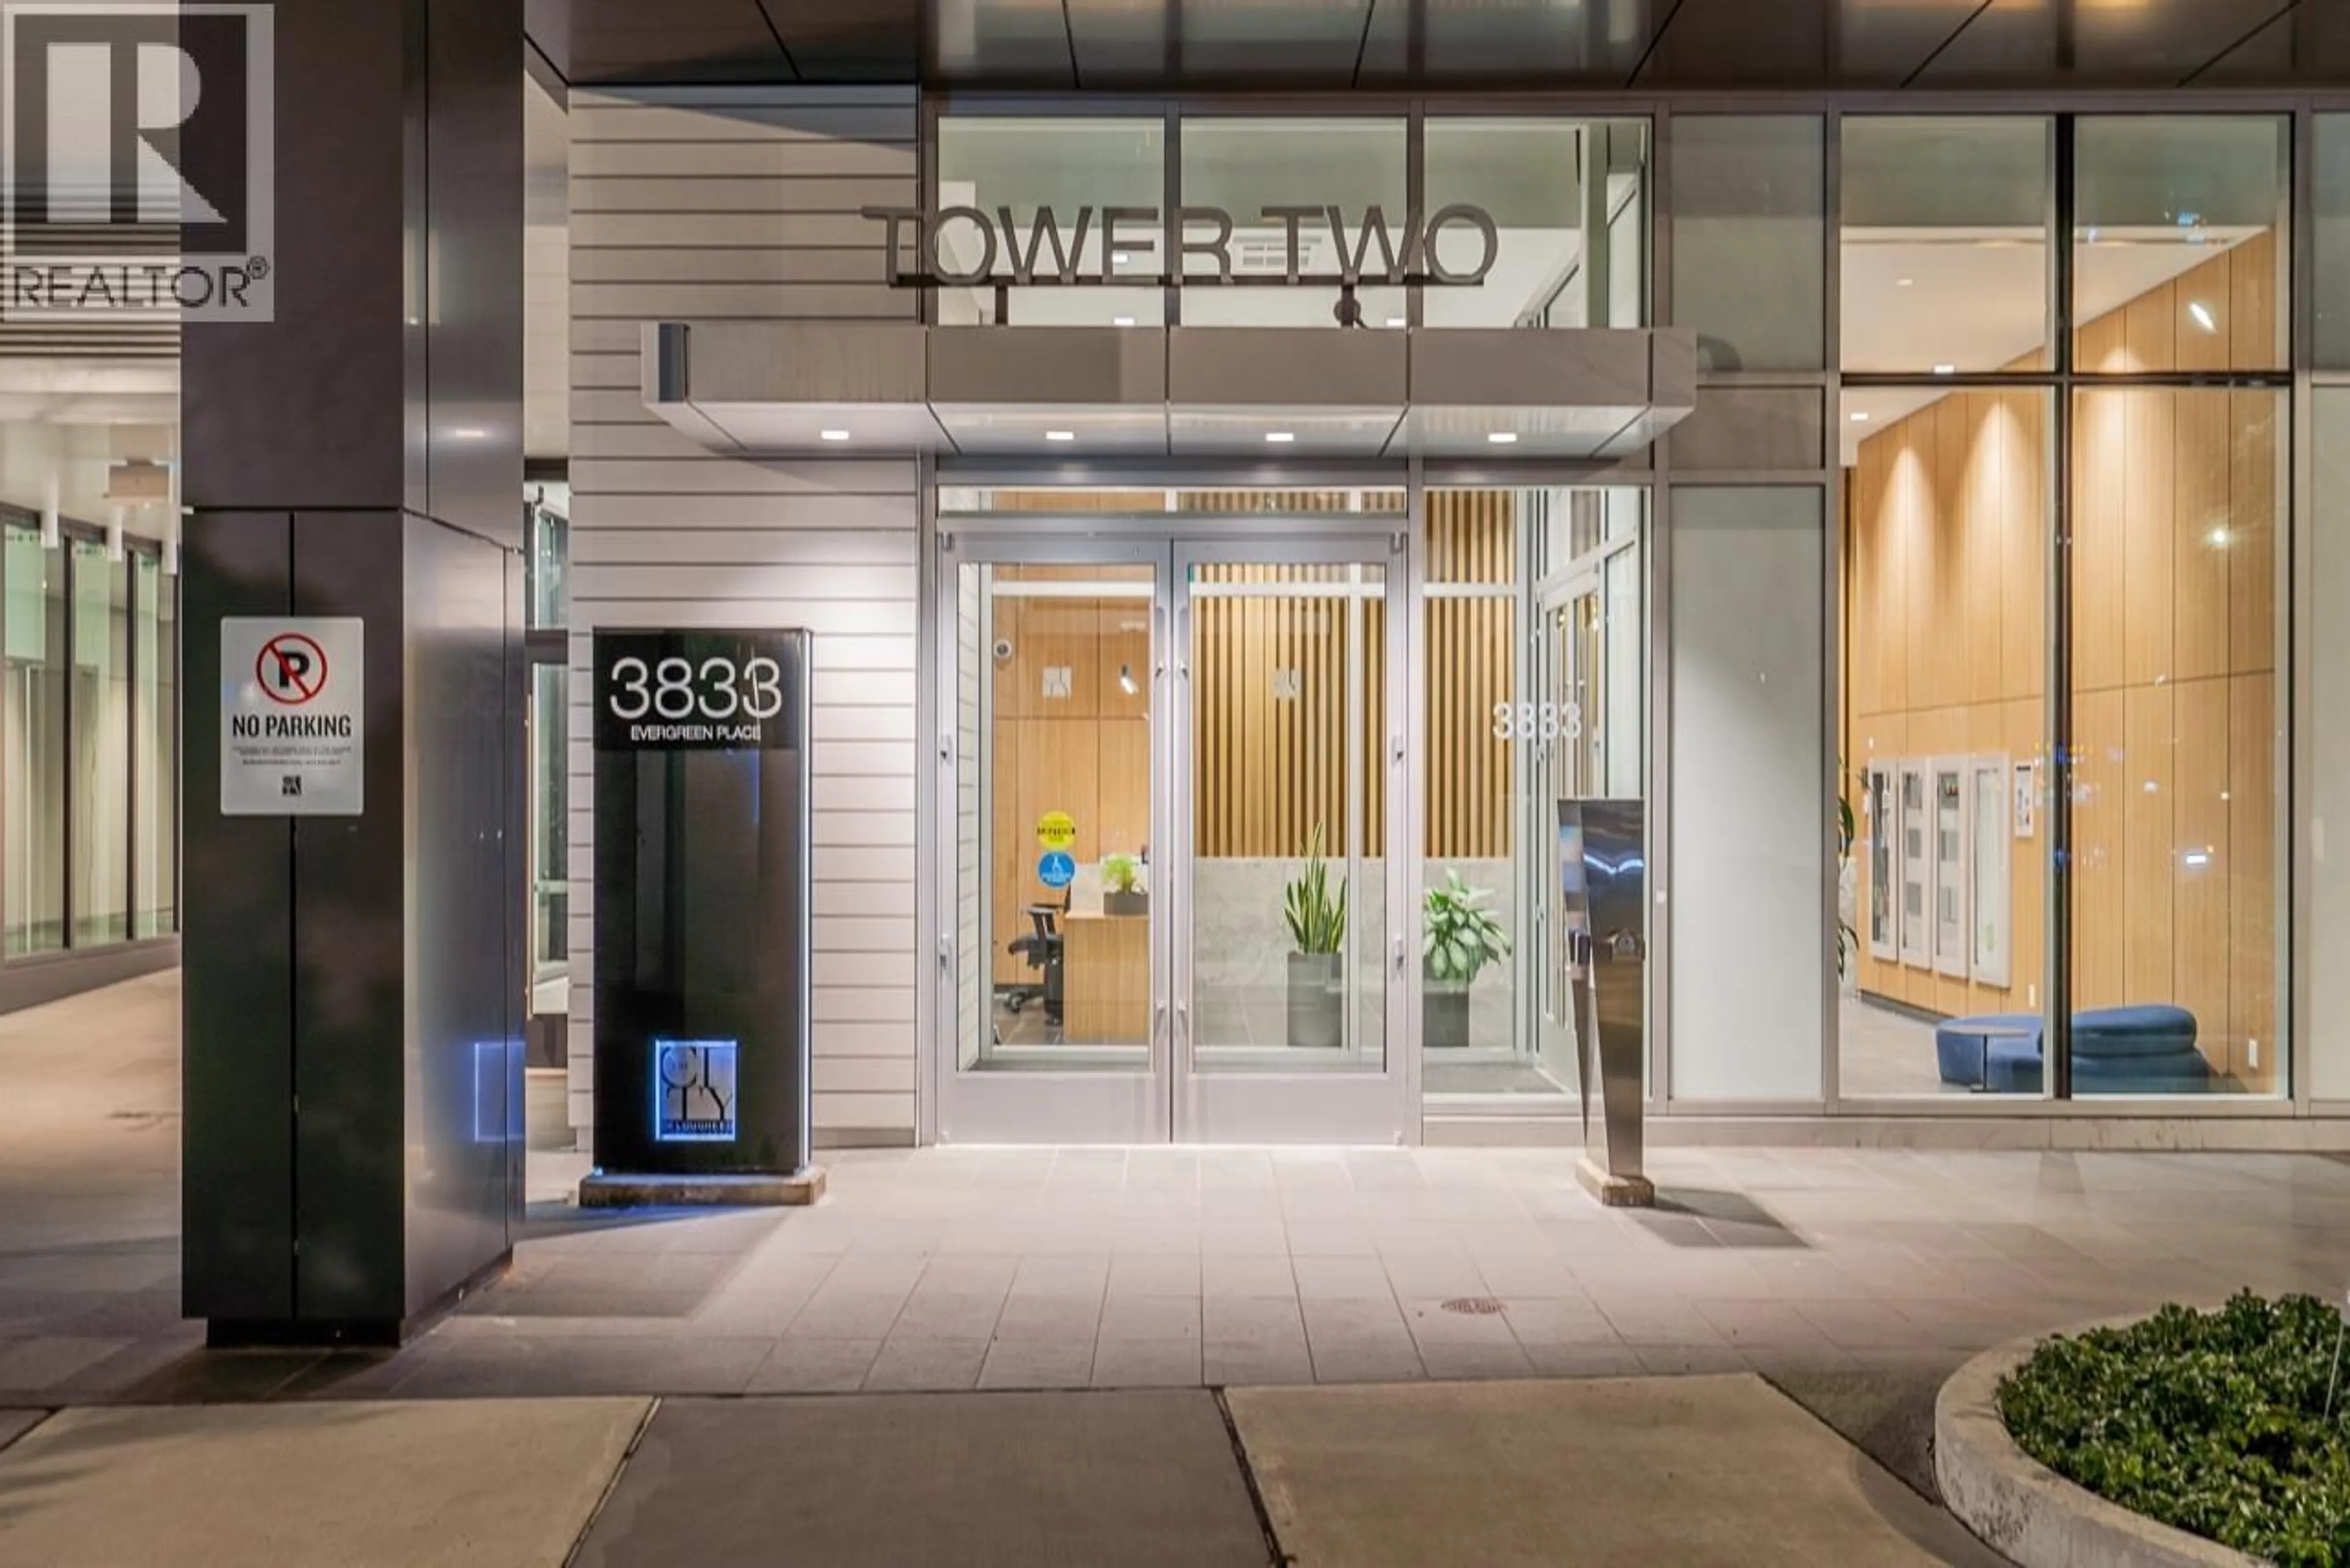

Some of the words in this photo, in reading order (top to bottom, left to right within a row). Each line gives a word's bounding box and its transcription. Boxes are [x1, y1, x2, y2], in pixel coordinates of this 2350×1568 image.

[861, 205, 1234, 284] TOWER
[1261, 204, 1498, 284] TWO
[610, 657, 782, 719] 3833
[233, 714, 260, 738] NO
[266, 714, 352, 738] PARKING
[631, 725, 714, 741] EVERGREEN
[716, 725, 761, 741] PLACE
